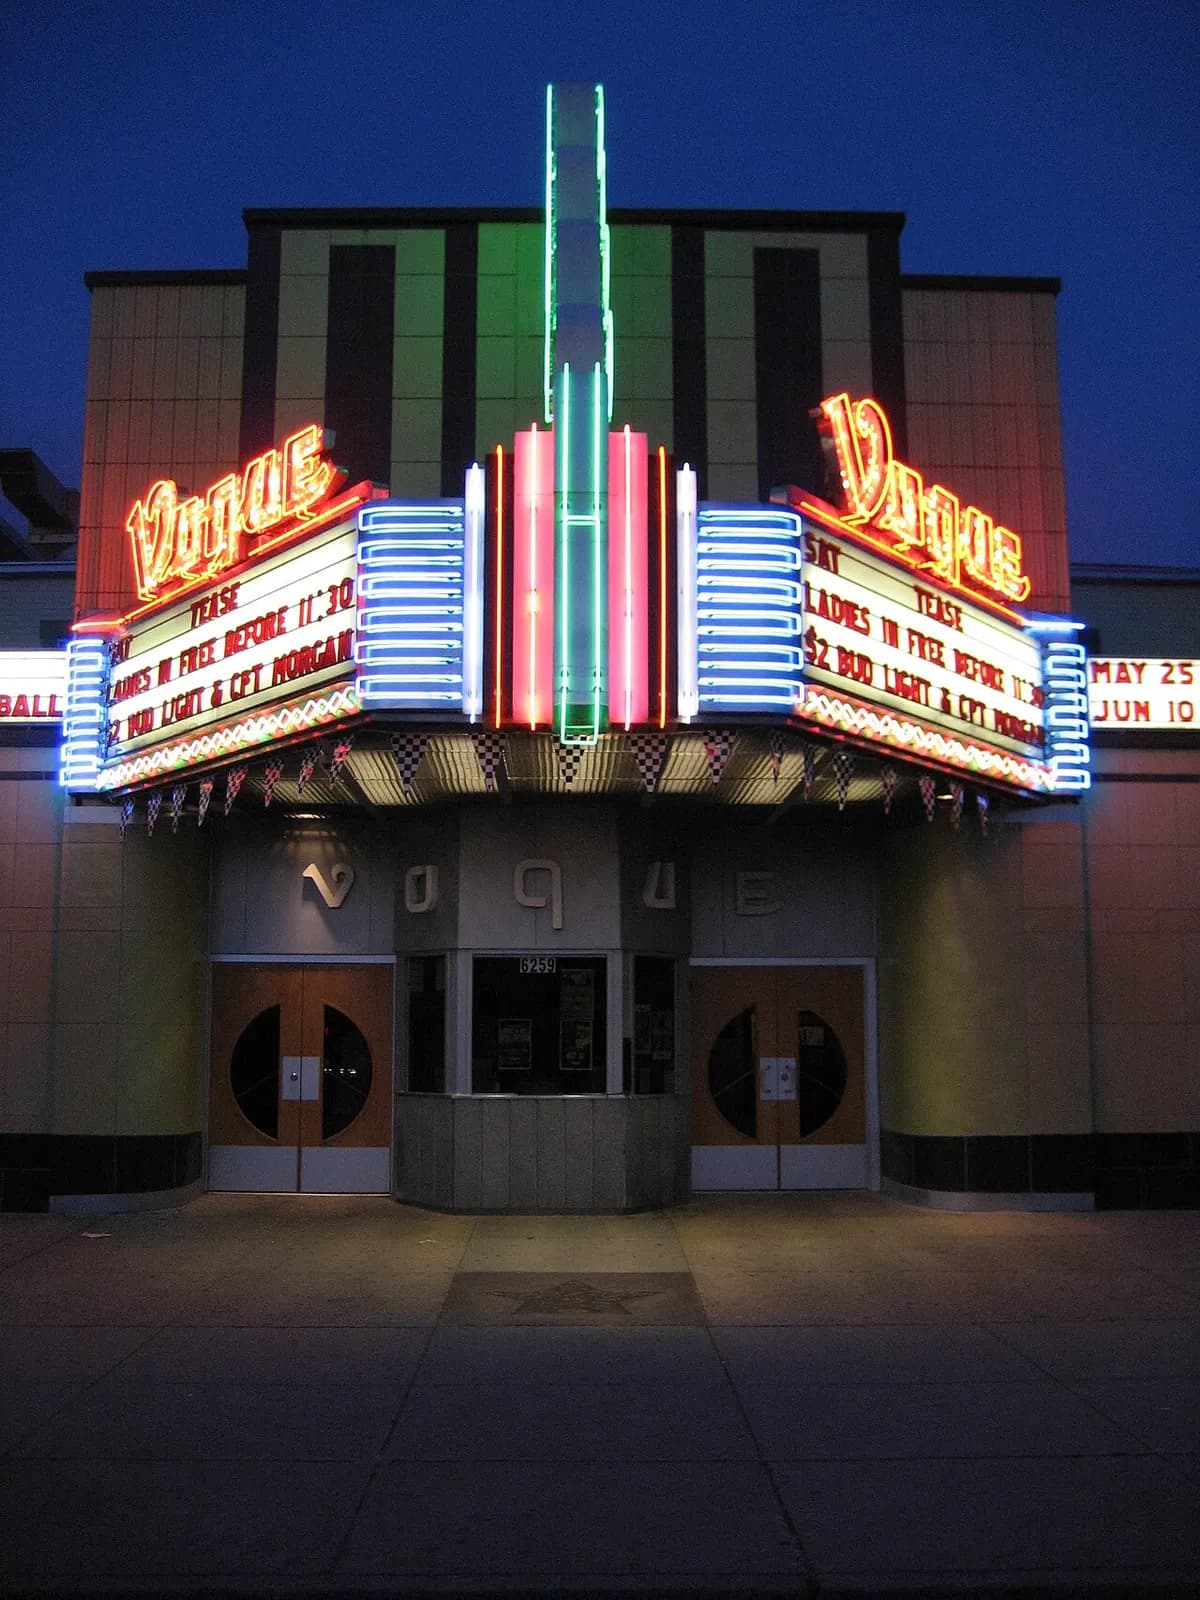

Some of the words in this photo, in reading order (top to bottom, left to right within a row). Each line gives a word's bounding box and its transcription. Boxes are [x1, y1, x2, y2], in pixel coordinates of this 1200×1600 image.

[803, 532, 840, 575] SAT
[190, 581, 240, 630] TEASE
[914, 585, 963, 632] TEASE
[158, 657, 172, 687] IN
[180, 637, 217, 677] FREE
[224, 605, 289, 658] BEFORE
[299, 577, 354, 628] 11:30
[804, 580, 870, 636] LADIES
[882, 616, 898, 648] IN
[908, 627, 945, 668] FREE
[953, 648, 1005, 693] BEFORE
[128, 706, 154, 740] BUD
[161, 687, 205, 727] LIGHT
[211, 680, 224, 708] &
[230, 663, 264, 701] CPT
[272, 628, 354, 687] MORGAN
[804, 625, 831, 671] $2
[837, 645, 873, 685] BUD
[884, 664, 931, 706] LIGHT
[940, 687, 950, 713] &
[959, 694, 986, 726] CPT
[993, 708, 1045, 748] MORGAN
[1091, 661, 1147, 684] MAY
[1160, 662, 1194, 685] 25
[0, 694, 64, 717] BALL
[1093, 700, 1151, 722] JUN
[1168, 700, 1195, 722] 10
[521, 957, 556, 973] 6259
